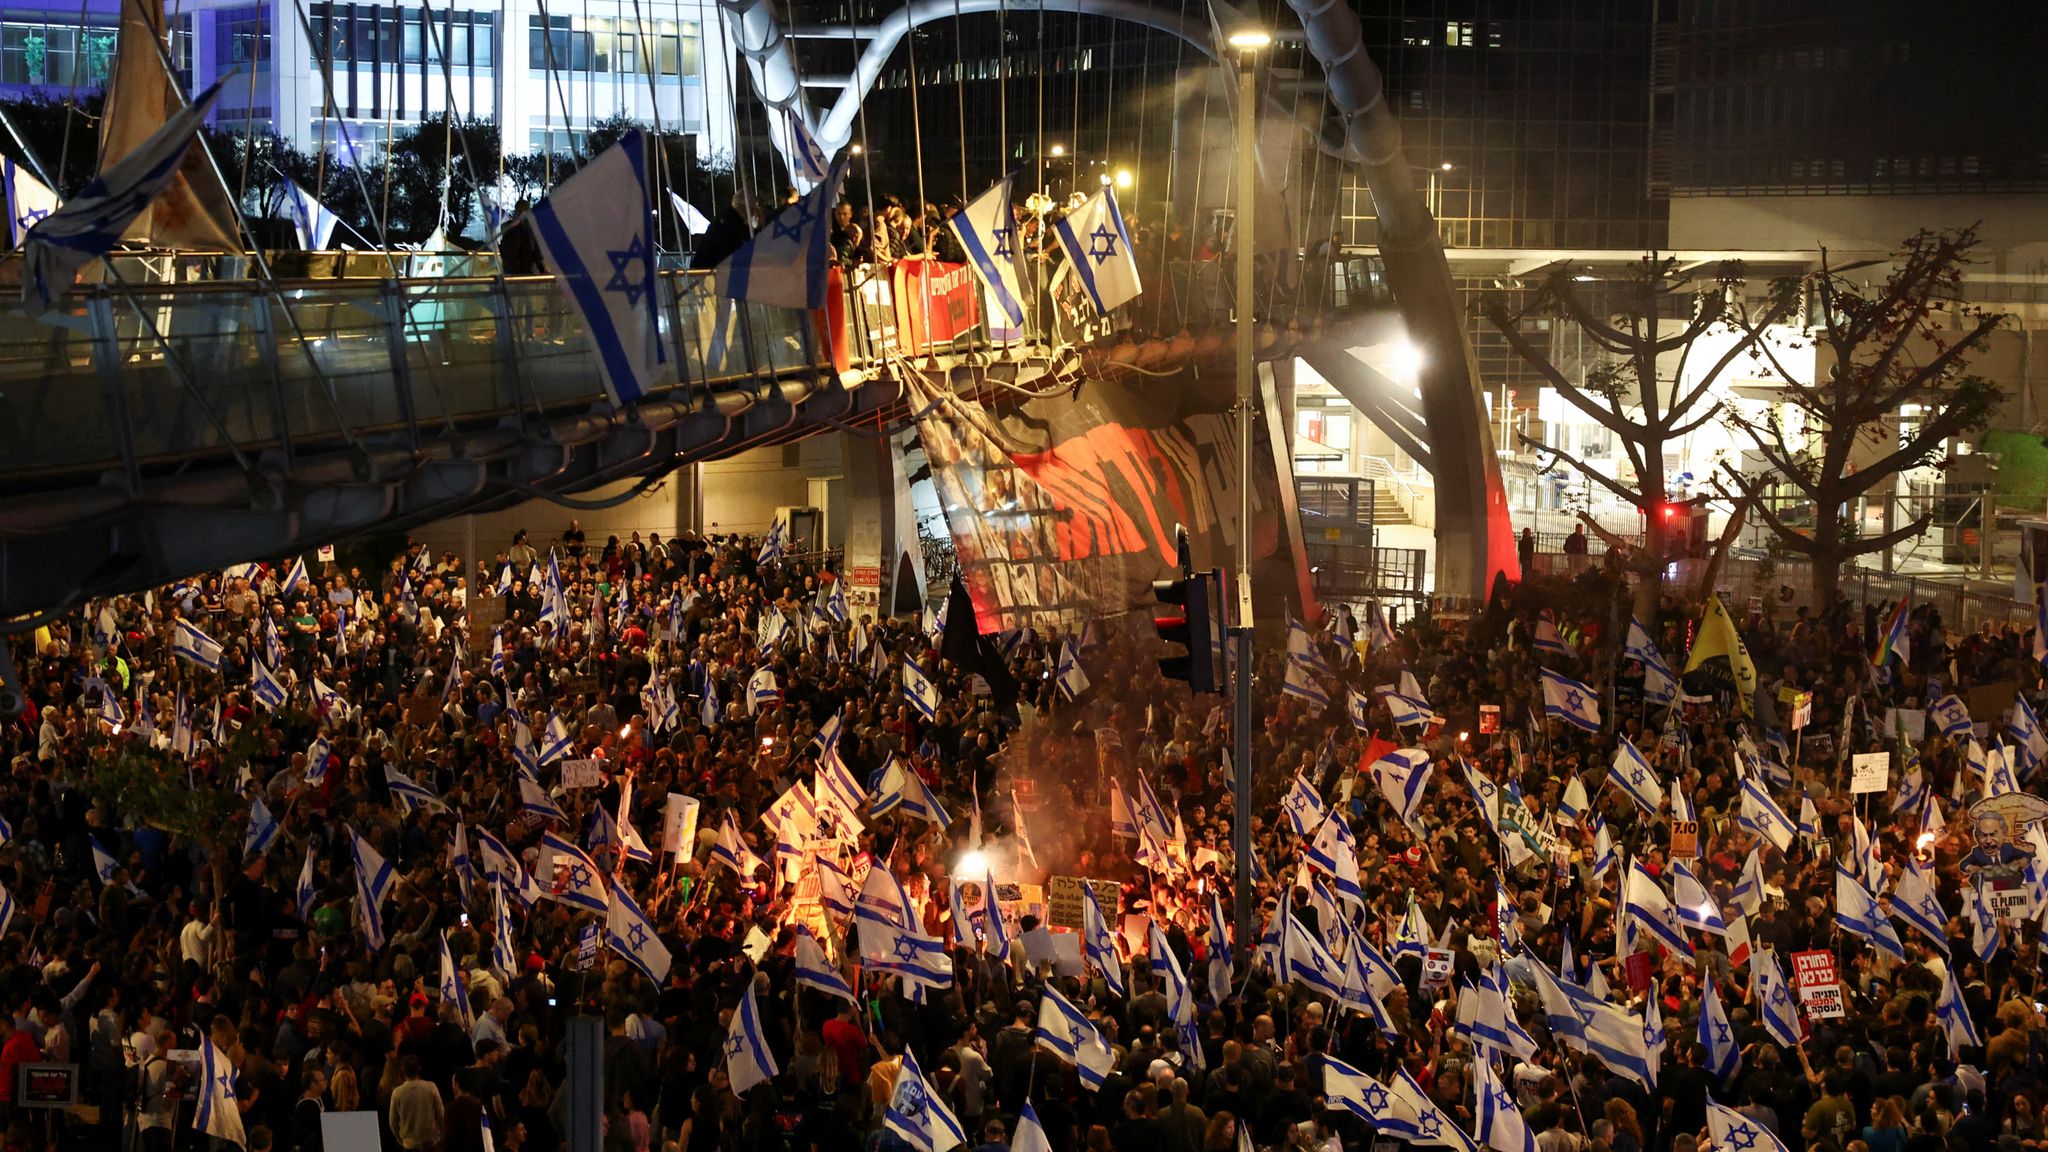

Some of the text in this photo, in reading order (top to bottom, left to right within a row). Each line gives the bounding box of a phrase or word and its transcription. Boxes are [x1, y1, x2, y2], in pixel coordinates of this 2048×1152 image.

[1673, 822, 1697, 834] 7.10
[2000, 895, 2027, 907] PLATINI
[1993, 907, 2011, 918] TING
[1797, 953, 1829, 971] החורבן
[1798, 968, 1834, 987] כבר כאן
[1811, 989, 1839, 999] נתניהו
[1811, 1003, 1842, 1014] לעסקה
